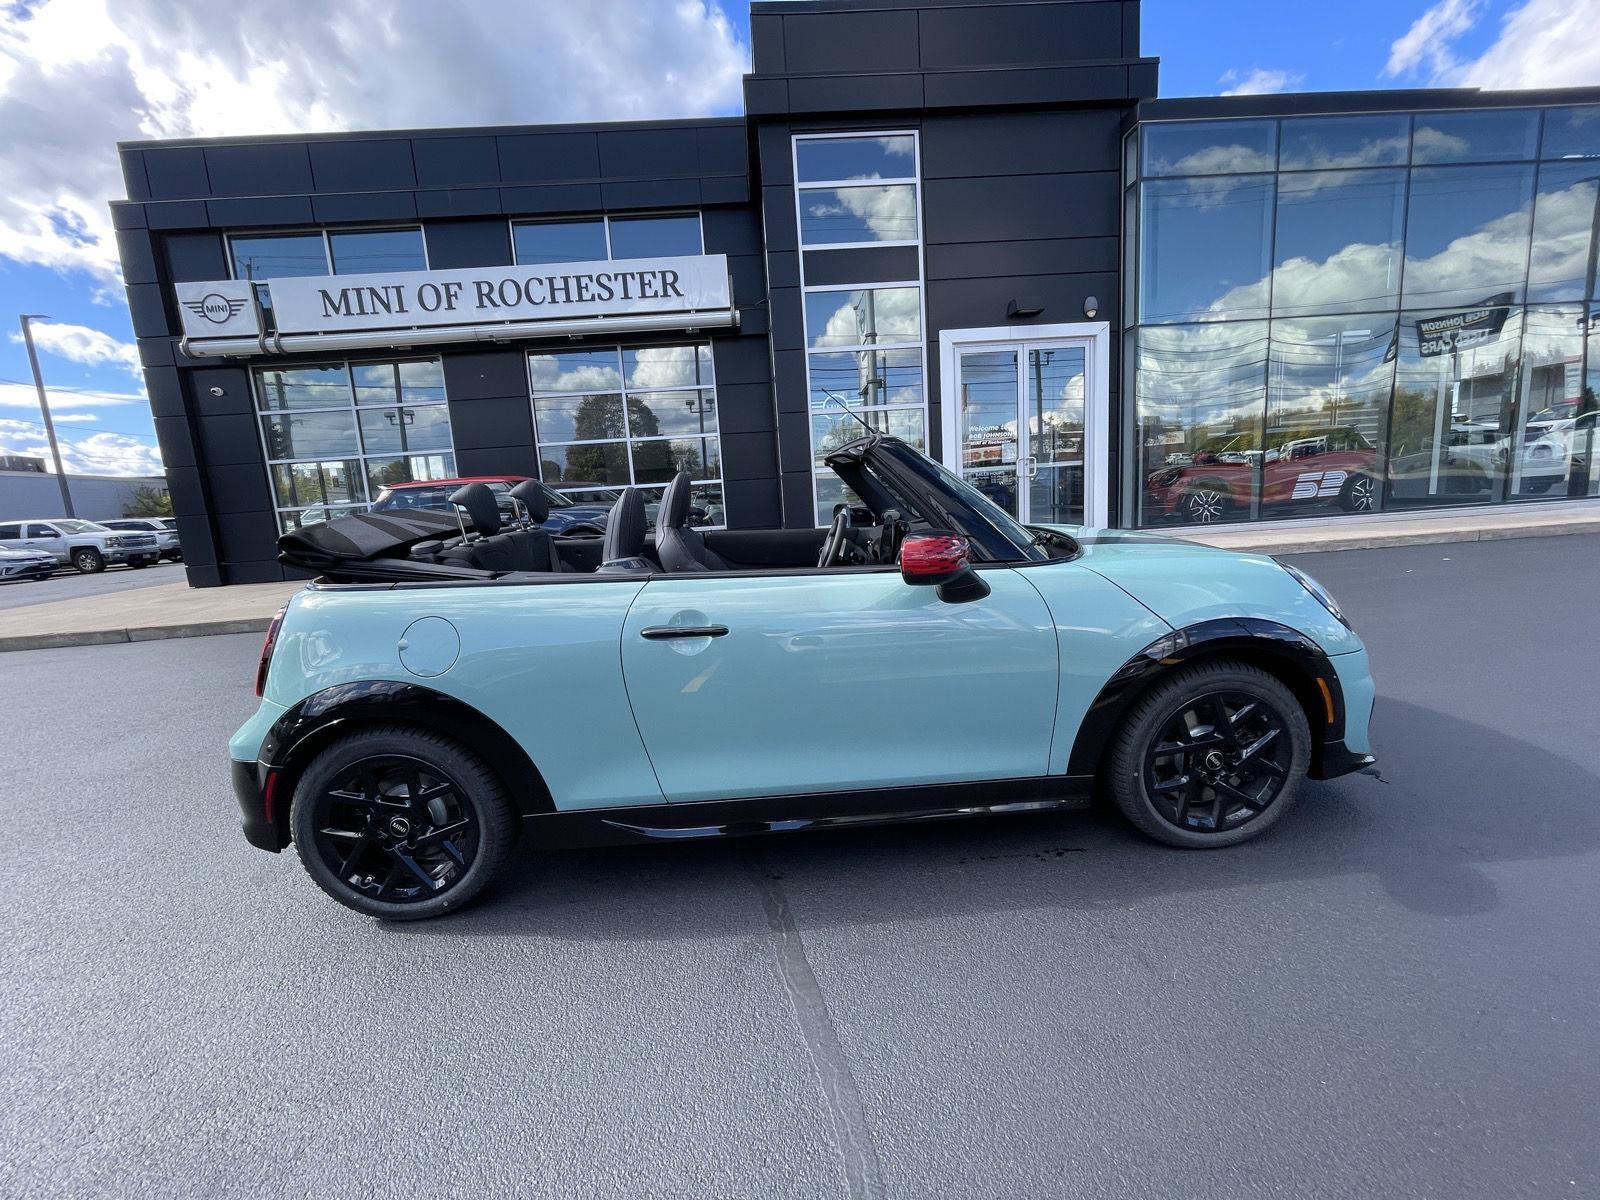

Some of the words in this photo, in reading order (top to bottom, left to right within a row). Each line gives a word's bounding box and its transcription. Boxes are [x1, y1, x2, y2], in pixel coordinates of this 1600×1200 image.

[318, 285, 409, 318] MINI
[417, 282, 463, 313] OF
[472, 269, 685, 309] ROCHESTER
[205, 304, 229, 314] MINI
[968, 424, 999, 432] Welcome
[983, 431, 1012, 439] JOHNSON
[1291, 470, 1348, 500] 52
[392, 822, 407, 833] MINI
